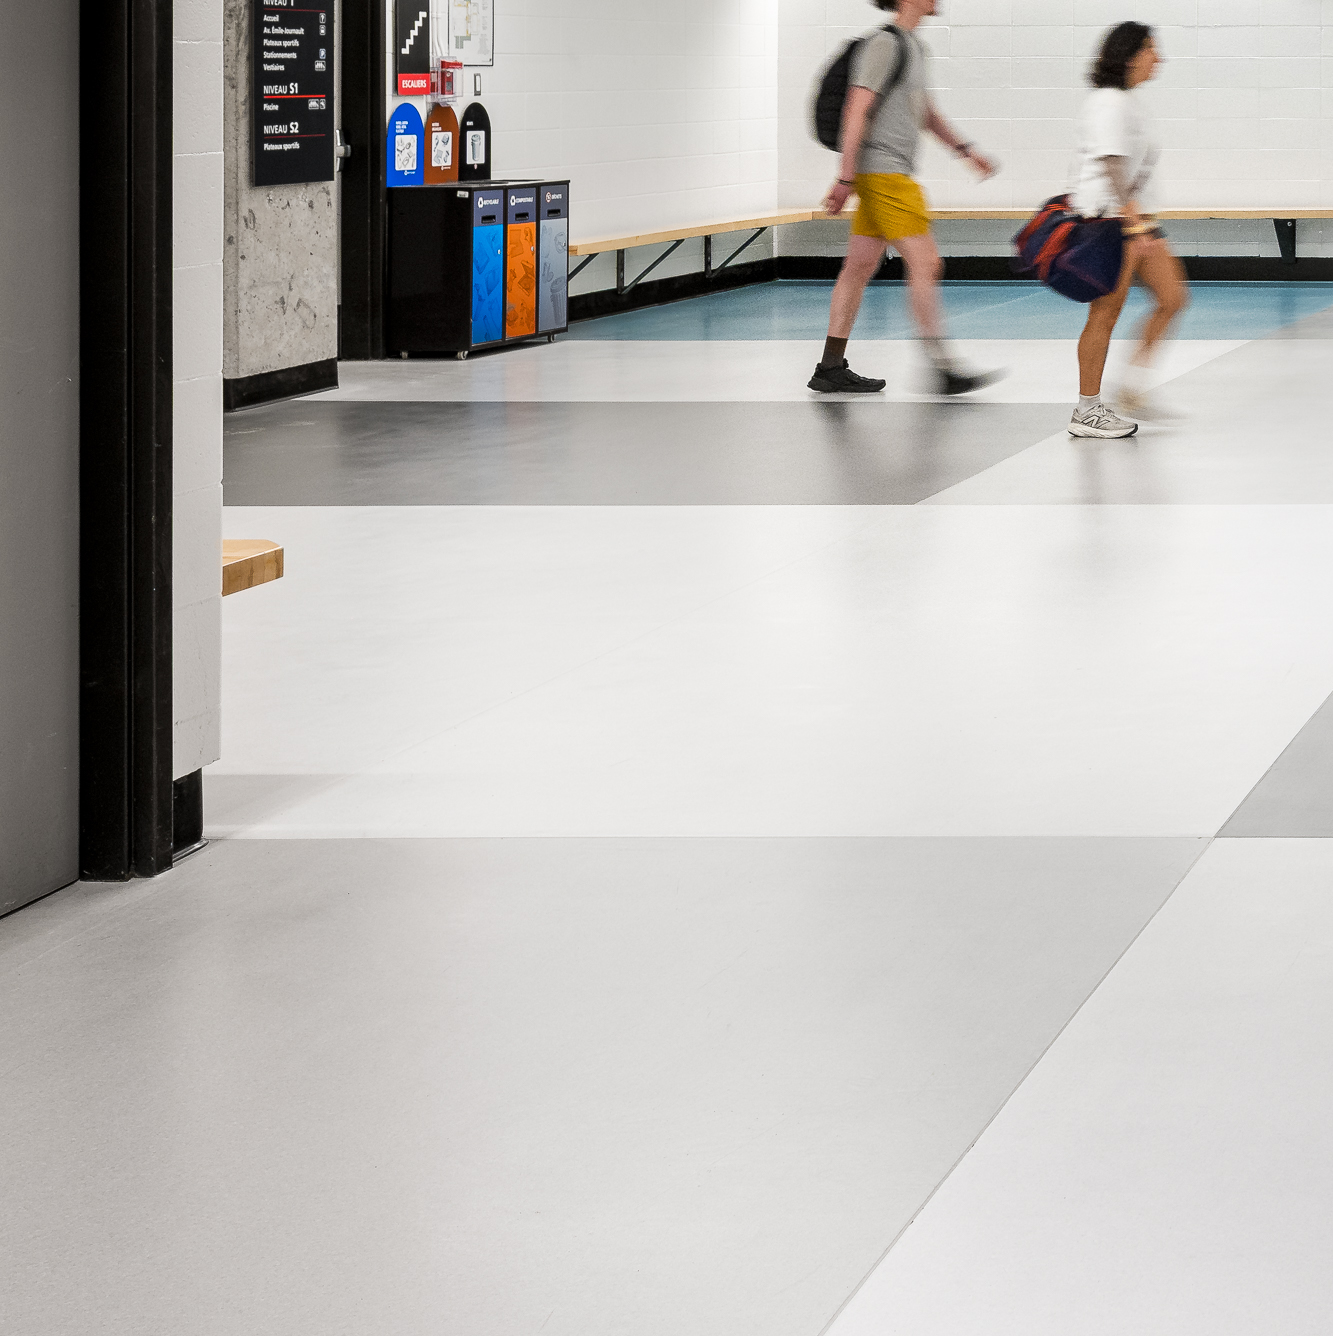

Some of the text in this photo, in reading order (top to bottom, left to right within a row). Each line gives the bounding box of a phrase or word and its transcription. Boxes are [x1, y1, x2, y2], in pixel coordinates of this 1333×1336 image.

[263, 14, 280, 22] Accueil
[263, 39, 300, 48] Plateaux sportifs
[263, 51, 297, 59] Stationnements
[263, 63, 285, 72] Vestiaires
[263, 82, 299, 94] NIVEAU S1
[401, 79, 428, 89] ESCALIERS
[263, 103, 279, 111] Piscine
[263, 121, 299, 135] NIVEAU S2
[263, 142, 300, 151] Plateaux sportifs
